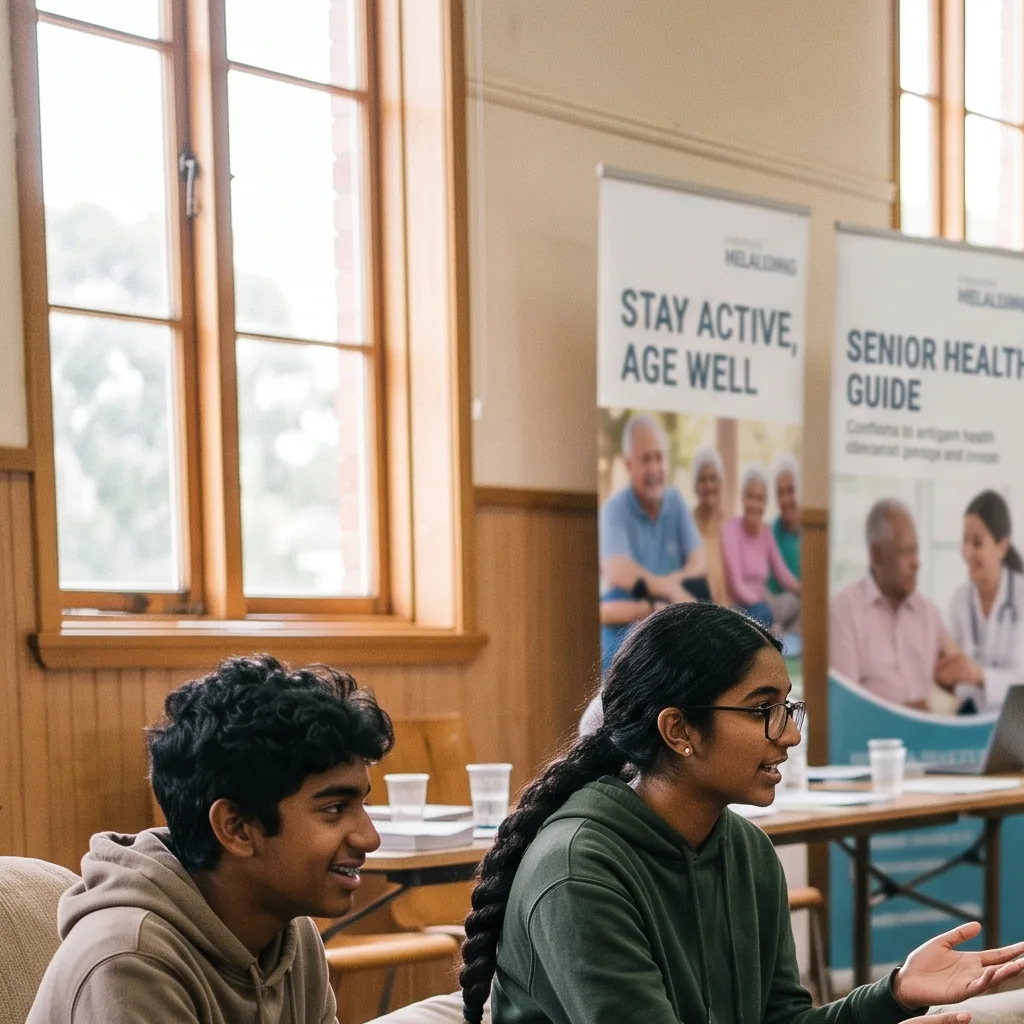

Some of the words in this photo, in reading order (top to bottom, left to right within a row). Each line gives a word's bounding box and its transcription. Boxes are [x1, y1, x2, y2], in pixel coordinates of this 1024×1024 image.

[621, 287, 690, 335] STAY
[696, 299, 798, 358] ACTIVE,
[620, 342, 678, 387] AGE
[686, 349, 759, 396] WELL
[846, 328, 937, 372] SENIOR
[846, 372, 922, 412] GUIDE
